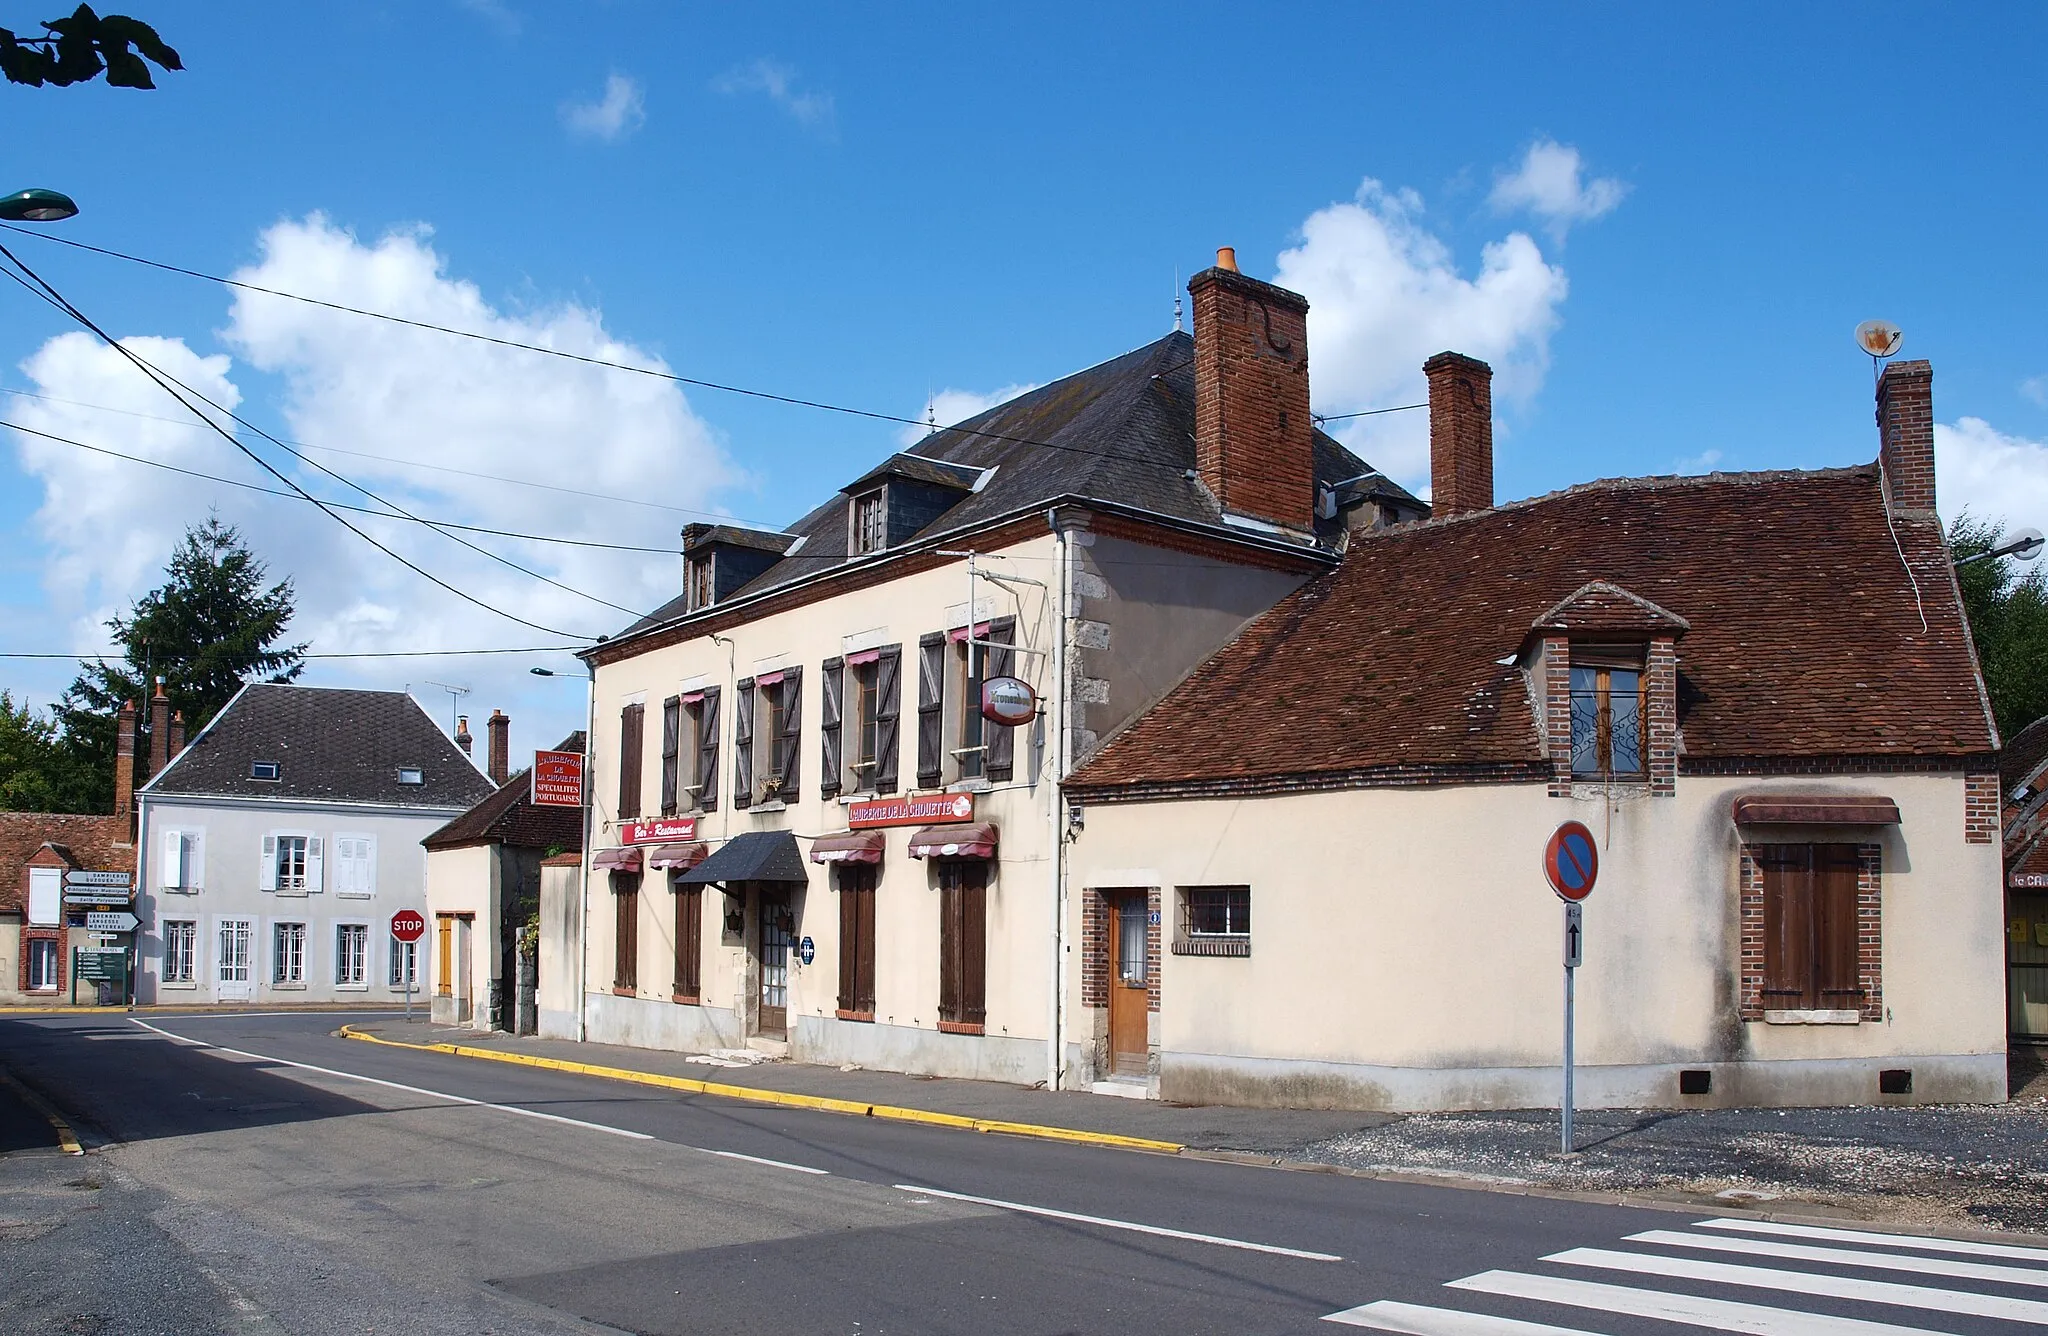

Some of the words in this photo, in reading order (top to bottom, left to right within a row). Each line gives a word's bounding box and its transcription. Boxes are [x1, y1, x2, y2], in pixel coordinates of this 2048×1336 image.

[547, 775, 580, 784] CHOUETTE
[537, 784, 579, 793] SPECIALITES
[535, 793, 580, 803] PORTUGAISES
[887, 806, 898, 819] DE
[898, 804, 908, 818] LA
[909, 802, 952, 818] CHOUETTE
[634, 826, 647, 838] Bar
[654, 824, 693, 836] Restaurant
[393, 920, 422, 931] STOP
